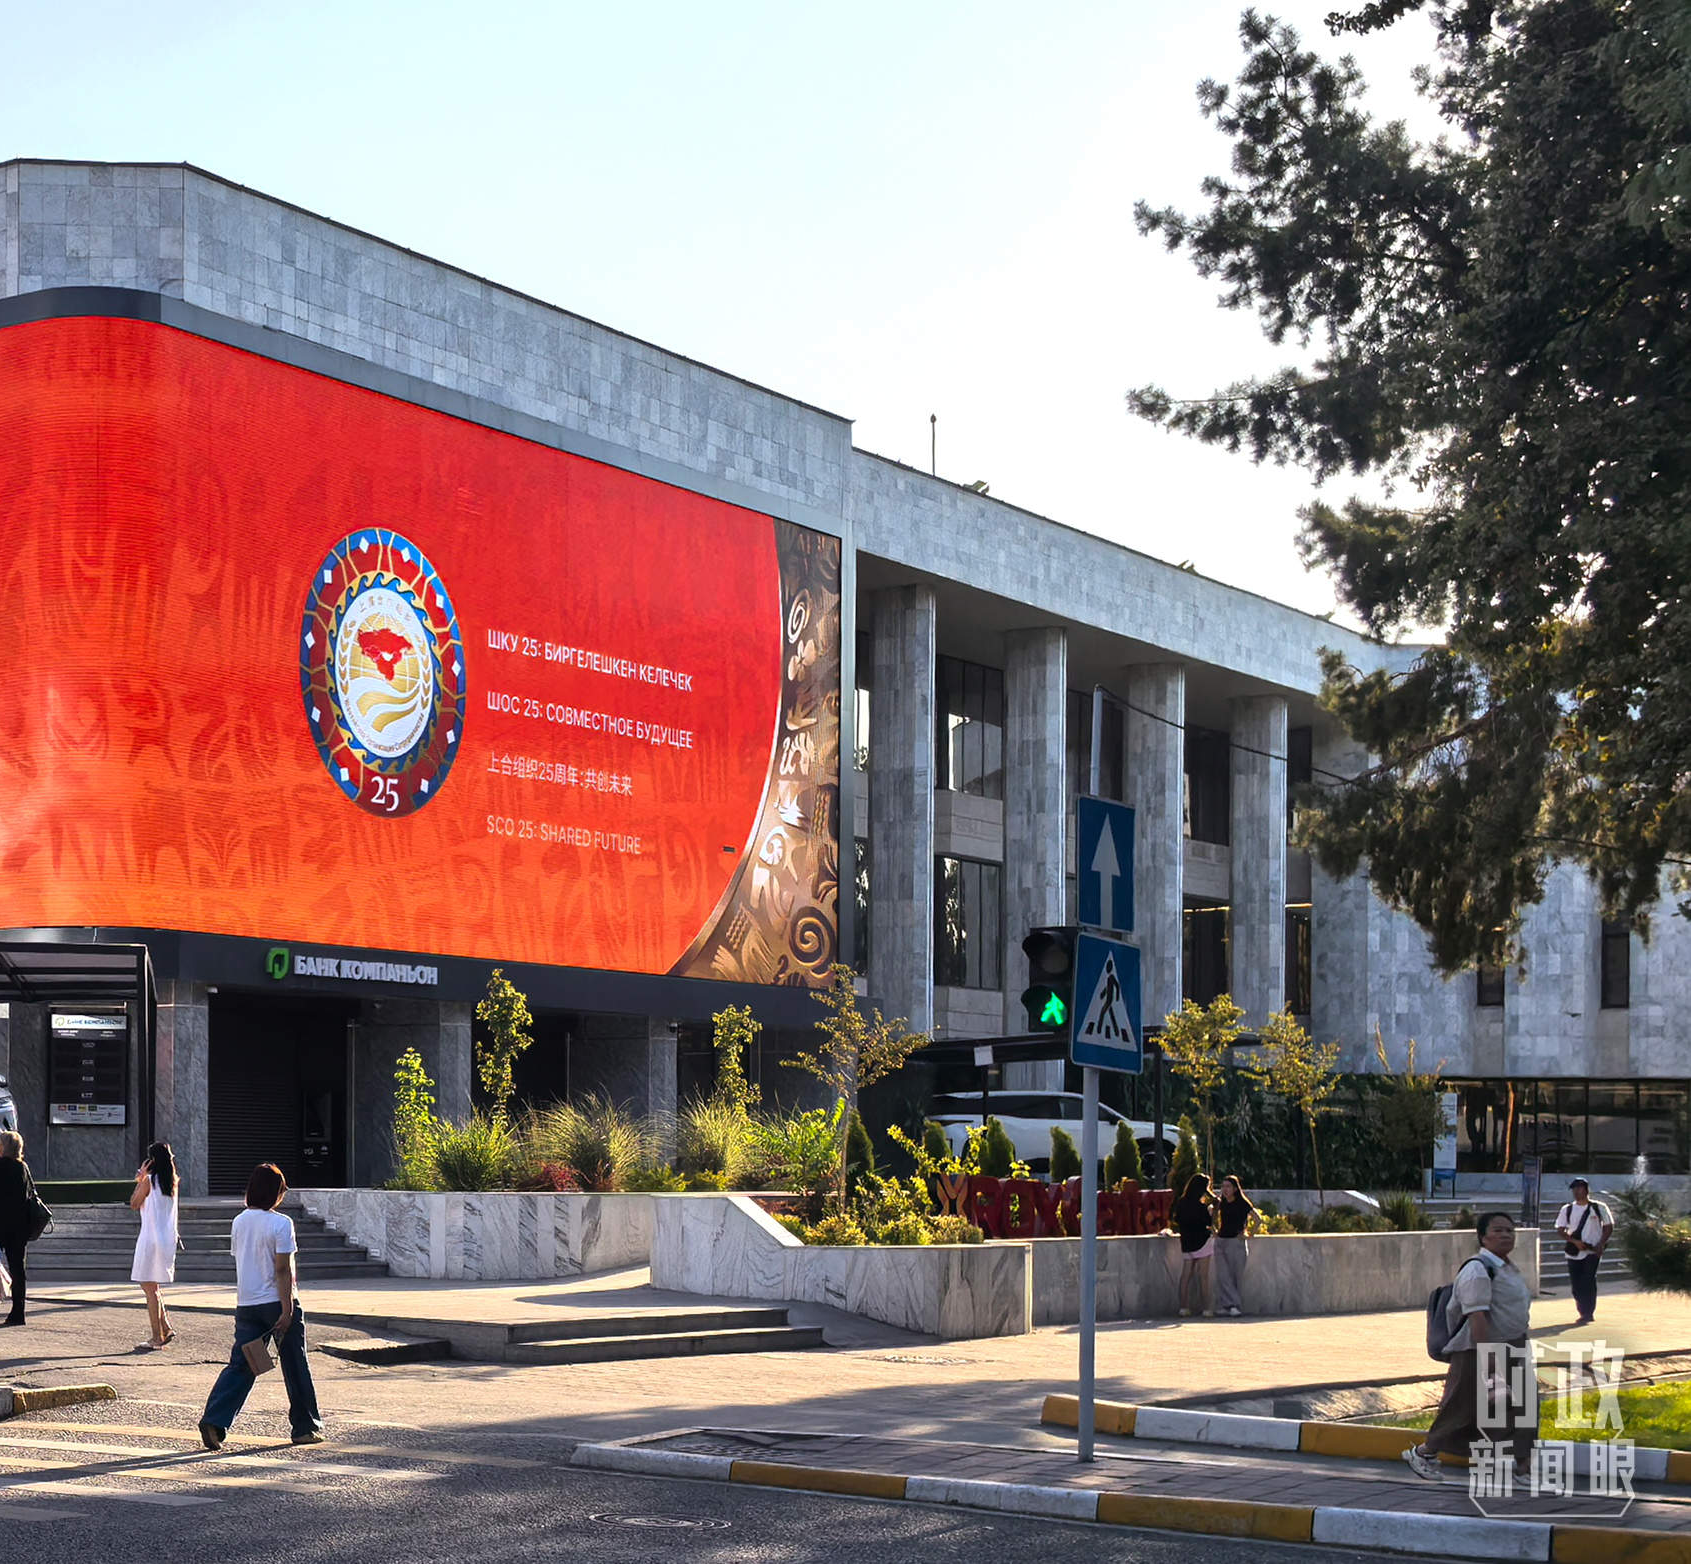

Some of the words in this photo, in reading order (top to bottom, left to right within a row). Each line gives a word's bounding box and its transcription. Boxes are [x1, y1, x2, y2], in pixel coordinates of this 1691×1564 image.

[487, 628, 519, 653] ШКУ
[522, 637, 542, 658] 25:
[545, 642, 637, 679] БИРГЕЛЕШКЕН
[639, 664, 693, 693] КЕЛЕЧЕК
[487, 691, 520, 714] ШОС
[523, 698, 544, 719] 25:
[546, 703, 634, 737] СОВМЕСТНОЕ
[636, 721, 694, 749] БУДУЩЕЕ
[370, 775, 399, 812] 25
[487, 815, 515, 836] SCO
[518, 818, 538, 839] 25:
[540, 823, 591, 847] SHARED
[594, 831, 642, 854] FUTURE
[294, 955, 339, 978] БАНК
[339, 959, 438, 985] КОМПАНЬОН
